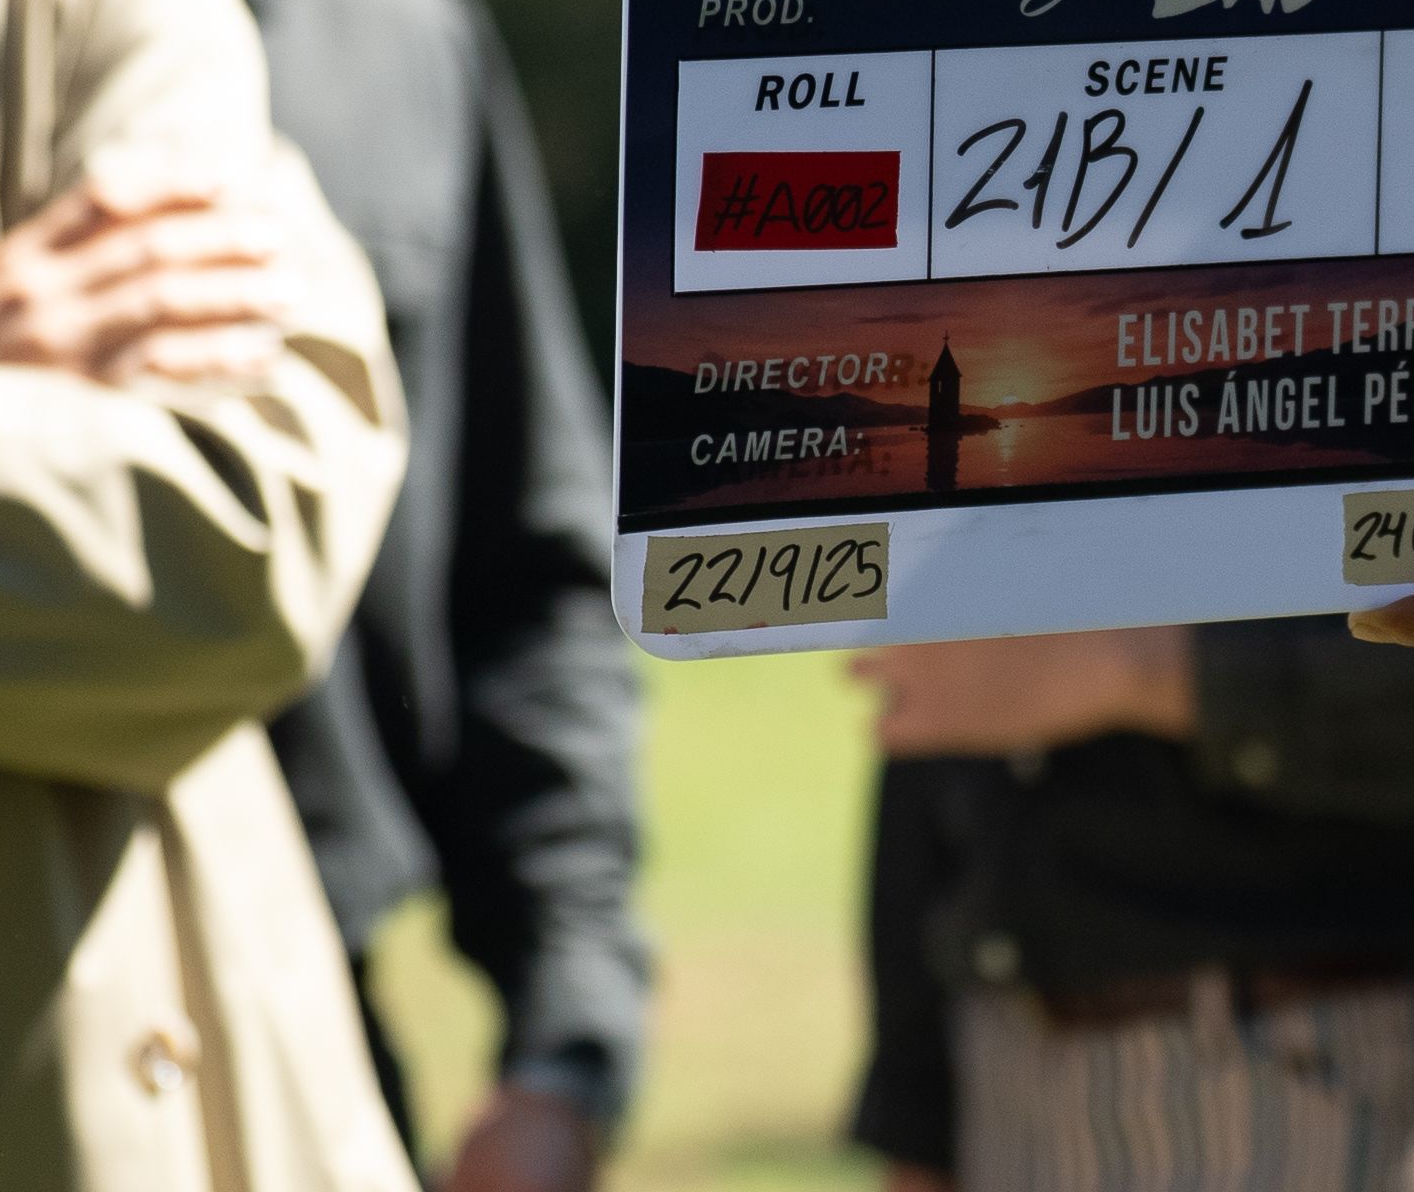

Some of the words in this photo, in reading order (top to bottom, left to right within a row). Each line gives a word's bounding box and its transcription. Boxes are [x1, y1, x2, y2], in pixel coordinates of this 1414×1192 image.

[754, 71, 866, 112] ROLL
[1085, 56, 1229, 97] SCENE
[1117, 304, 1311, 368] ELISABET
[694, 352, 902, 394] DIRECTOR:
[1111, 382, 1201, 442] LUIS
[1216, 370, 1346, 435] ÁNGEL
[690, 425, 864, 466] CAMERA:
[664, 539, 883, 612] 22/9/25
